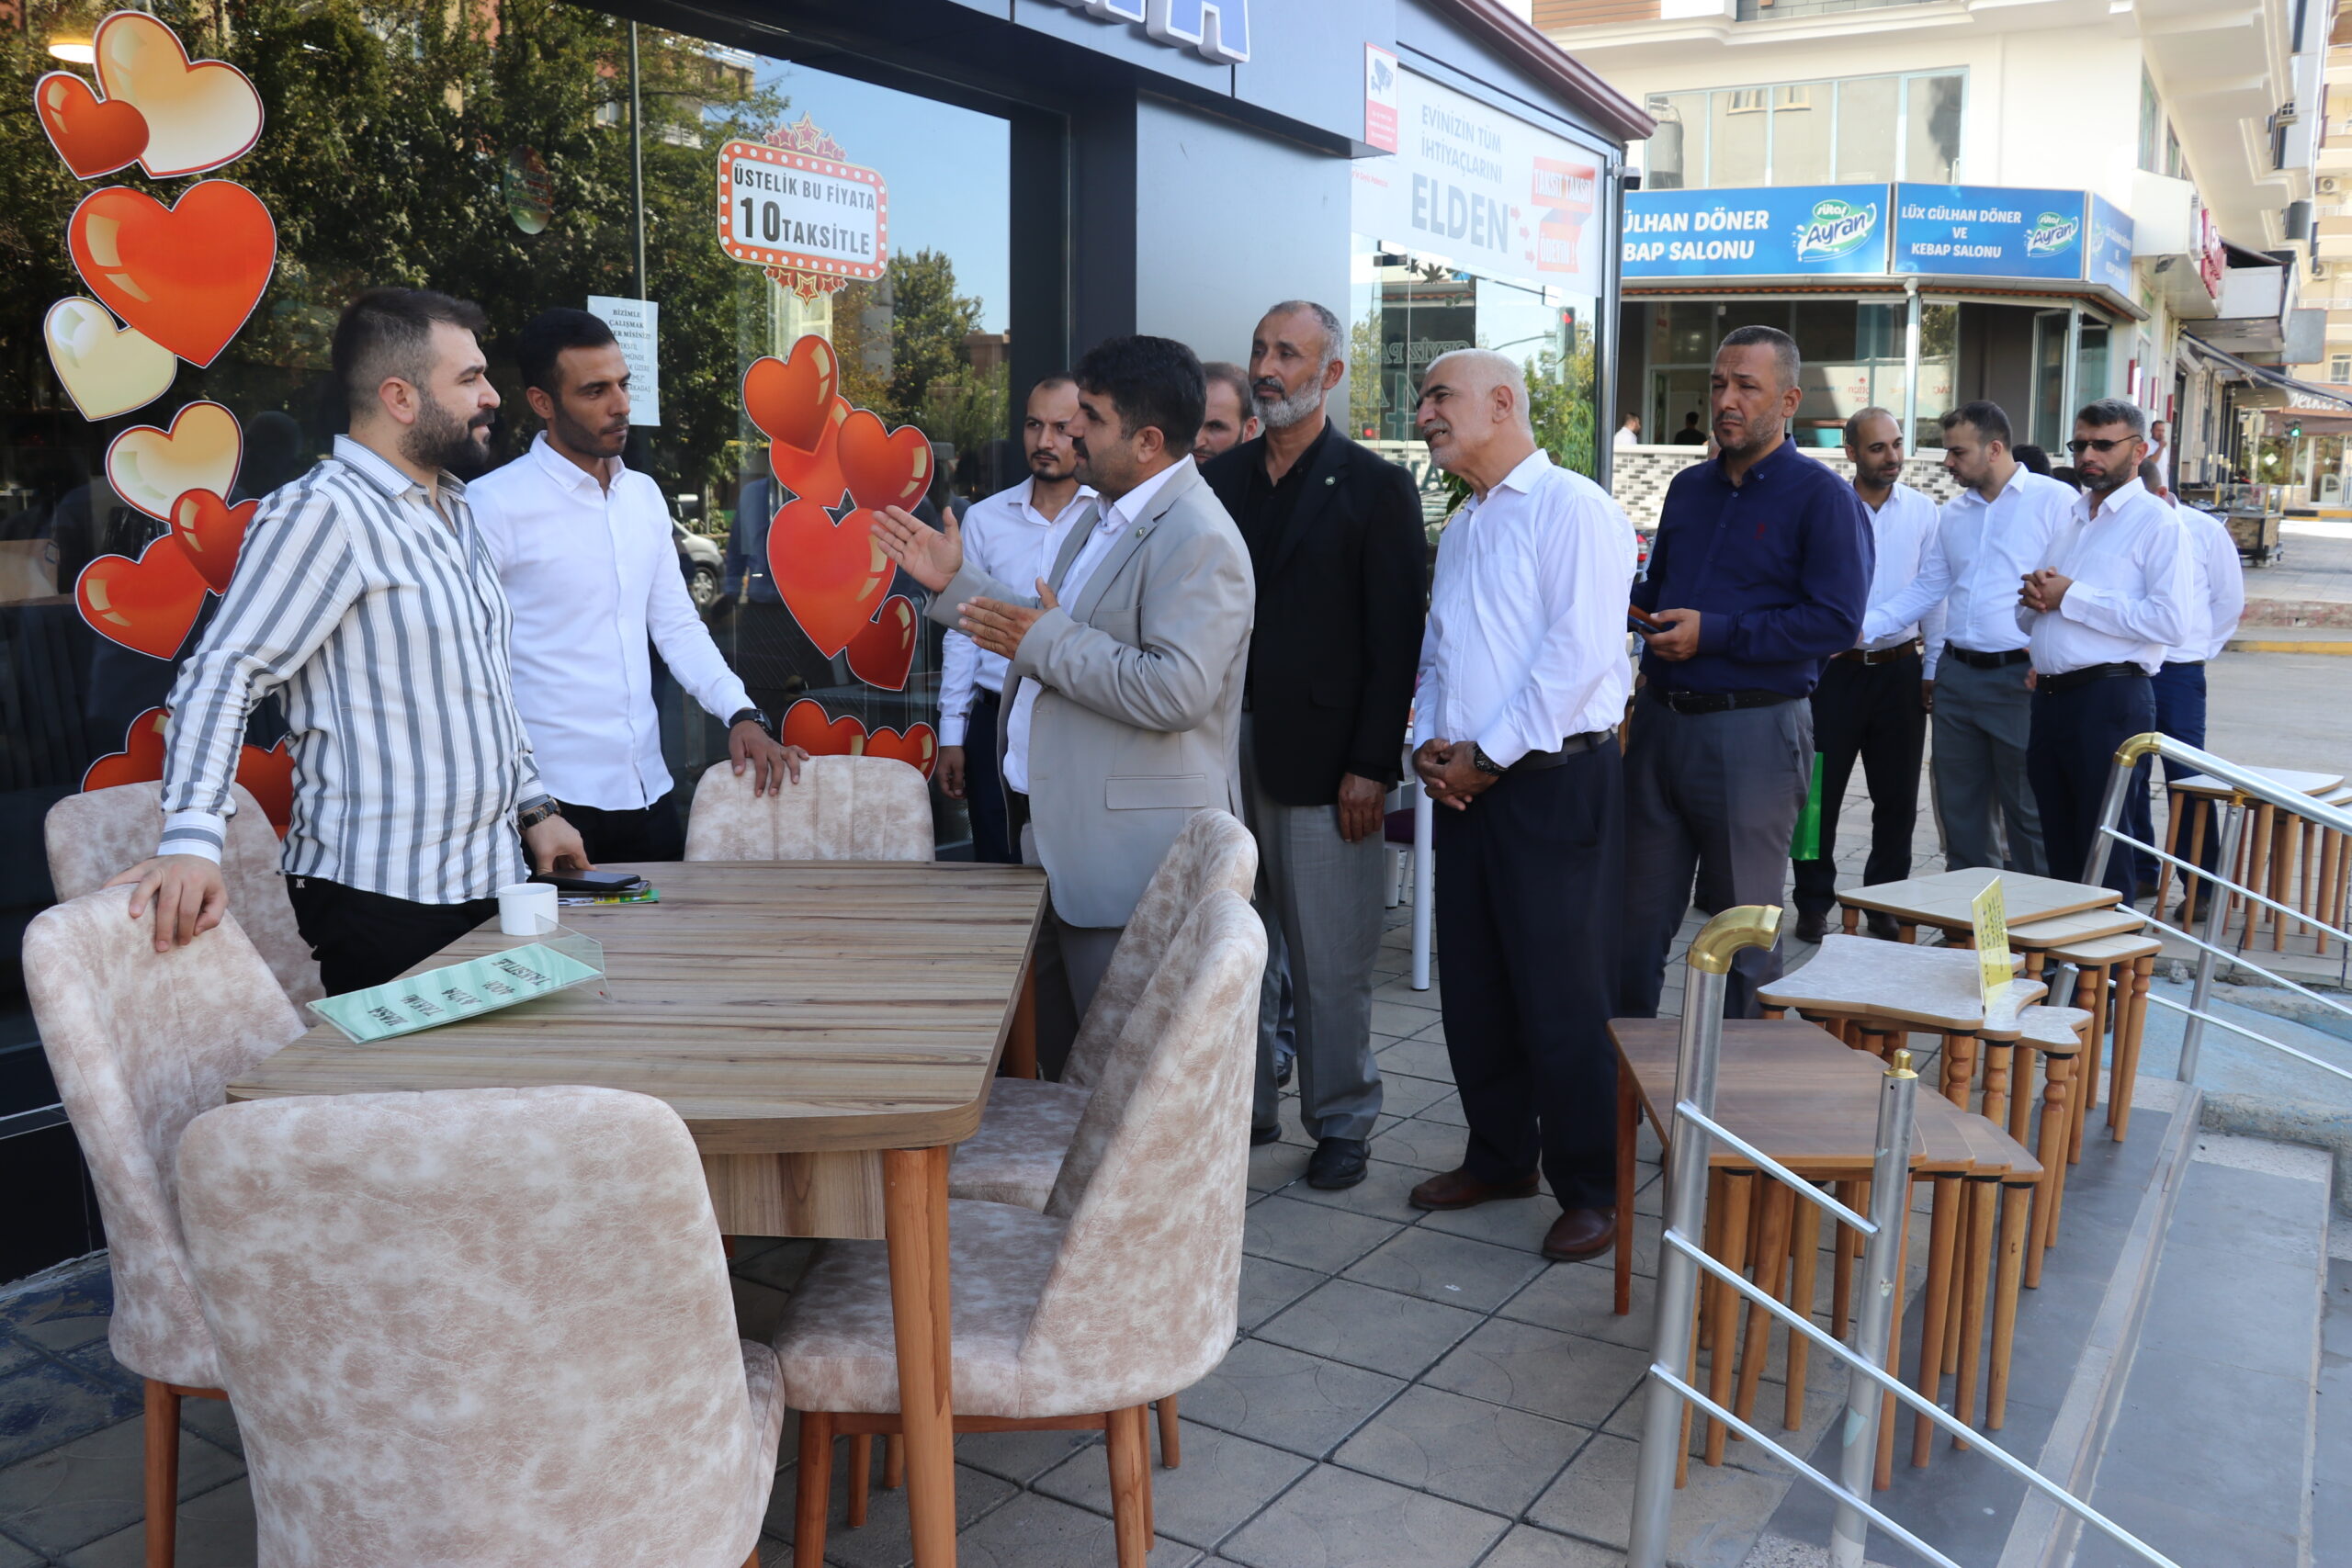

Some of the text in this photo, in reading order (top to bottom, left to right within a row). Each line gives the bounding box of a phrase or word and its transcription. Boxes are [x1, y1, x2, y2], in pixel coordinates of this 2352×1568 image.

[1421, 104, 1475, 142] EVİNİZİN
[1477, 125, 1501, 154] TÜM
[1421, 131, 1503, 185] İHTİYAÇLARINI
[734, 164, 876, 211] ÜSTELİK BU FİYATA
[1411, 172, 1510, 254] ELDEN
[1623, 206, 1770, 233] ÜLHAN DÖNER
[1902, 204, 2021, 223] LÜX GÜLHAN DÖNER
[1805, 213, 1866, 247] Ayran
[1952, 227, 1968, 239] VE
[2033, 223, 2073, 246] Ayran
[1623, 240, 1755, 262] BAP SALONU
[1911, 243, 2002, 258] KEBAP SALONU
